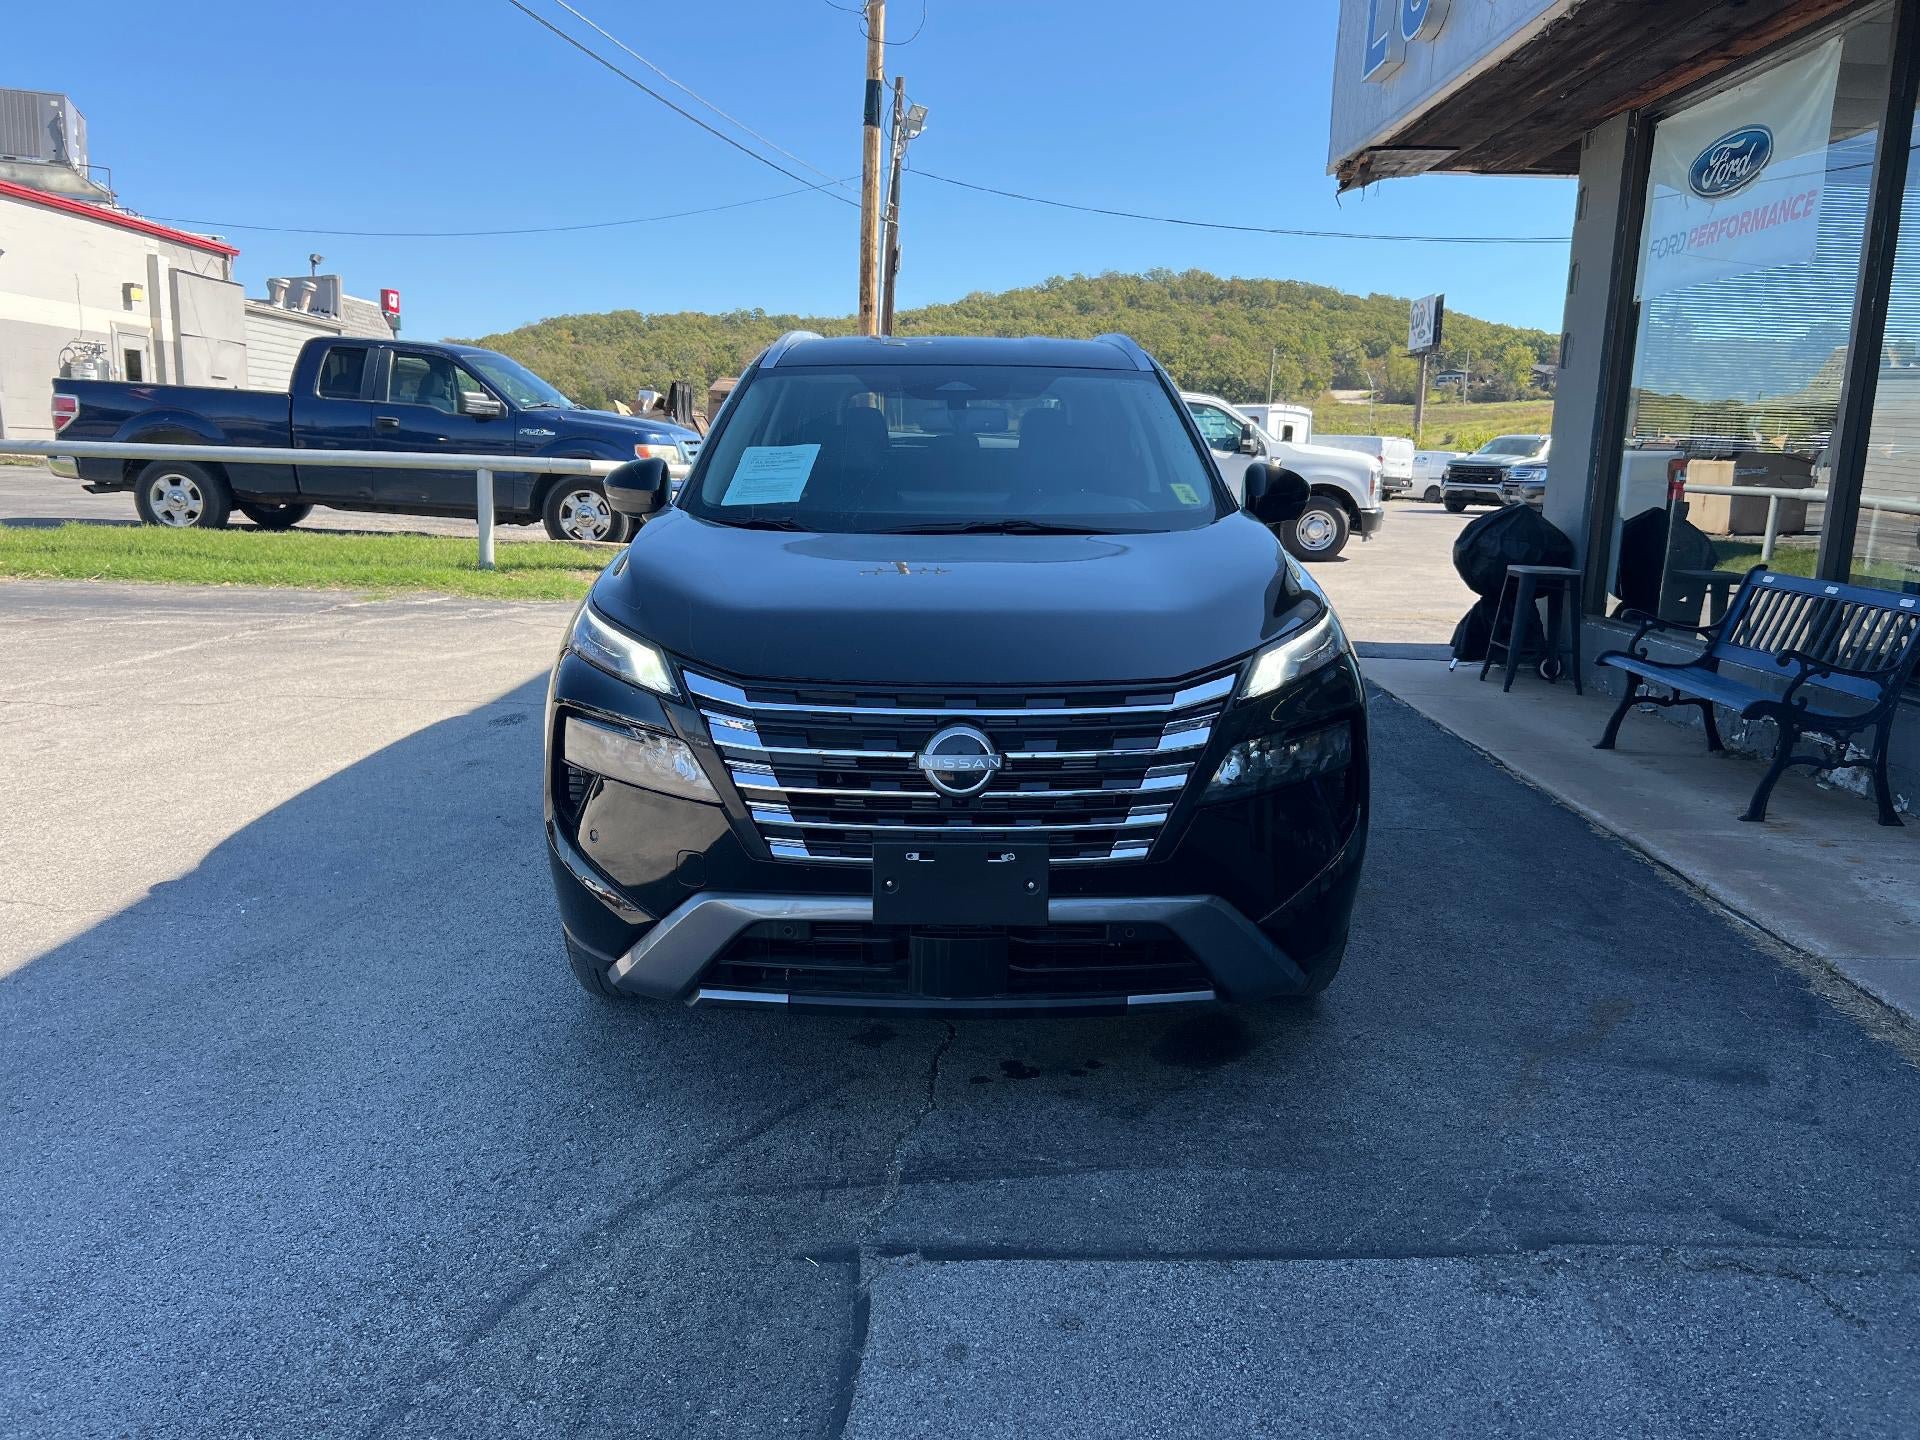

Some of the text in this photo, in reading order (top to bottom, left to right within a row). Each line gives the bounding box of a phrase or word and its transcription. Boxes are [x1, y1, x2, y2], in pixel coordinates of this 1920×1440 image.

[1701, 138, 1758, 189] Ford
[1650, 189, 1818, 258] FORD PERFORMANCE
[920, 757, 1001, 769] NISSAN
